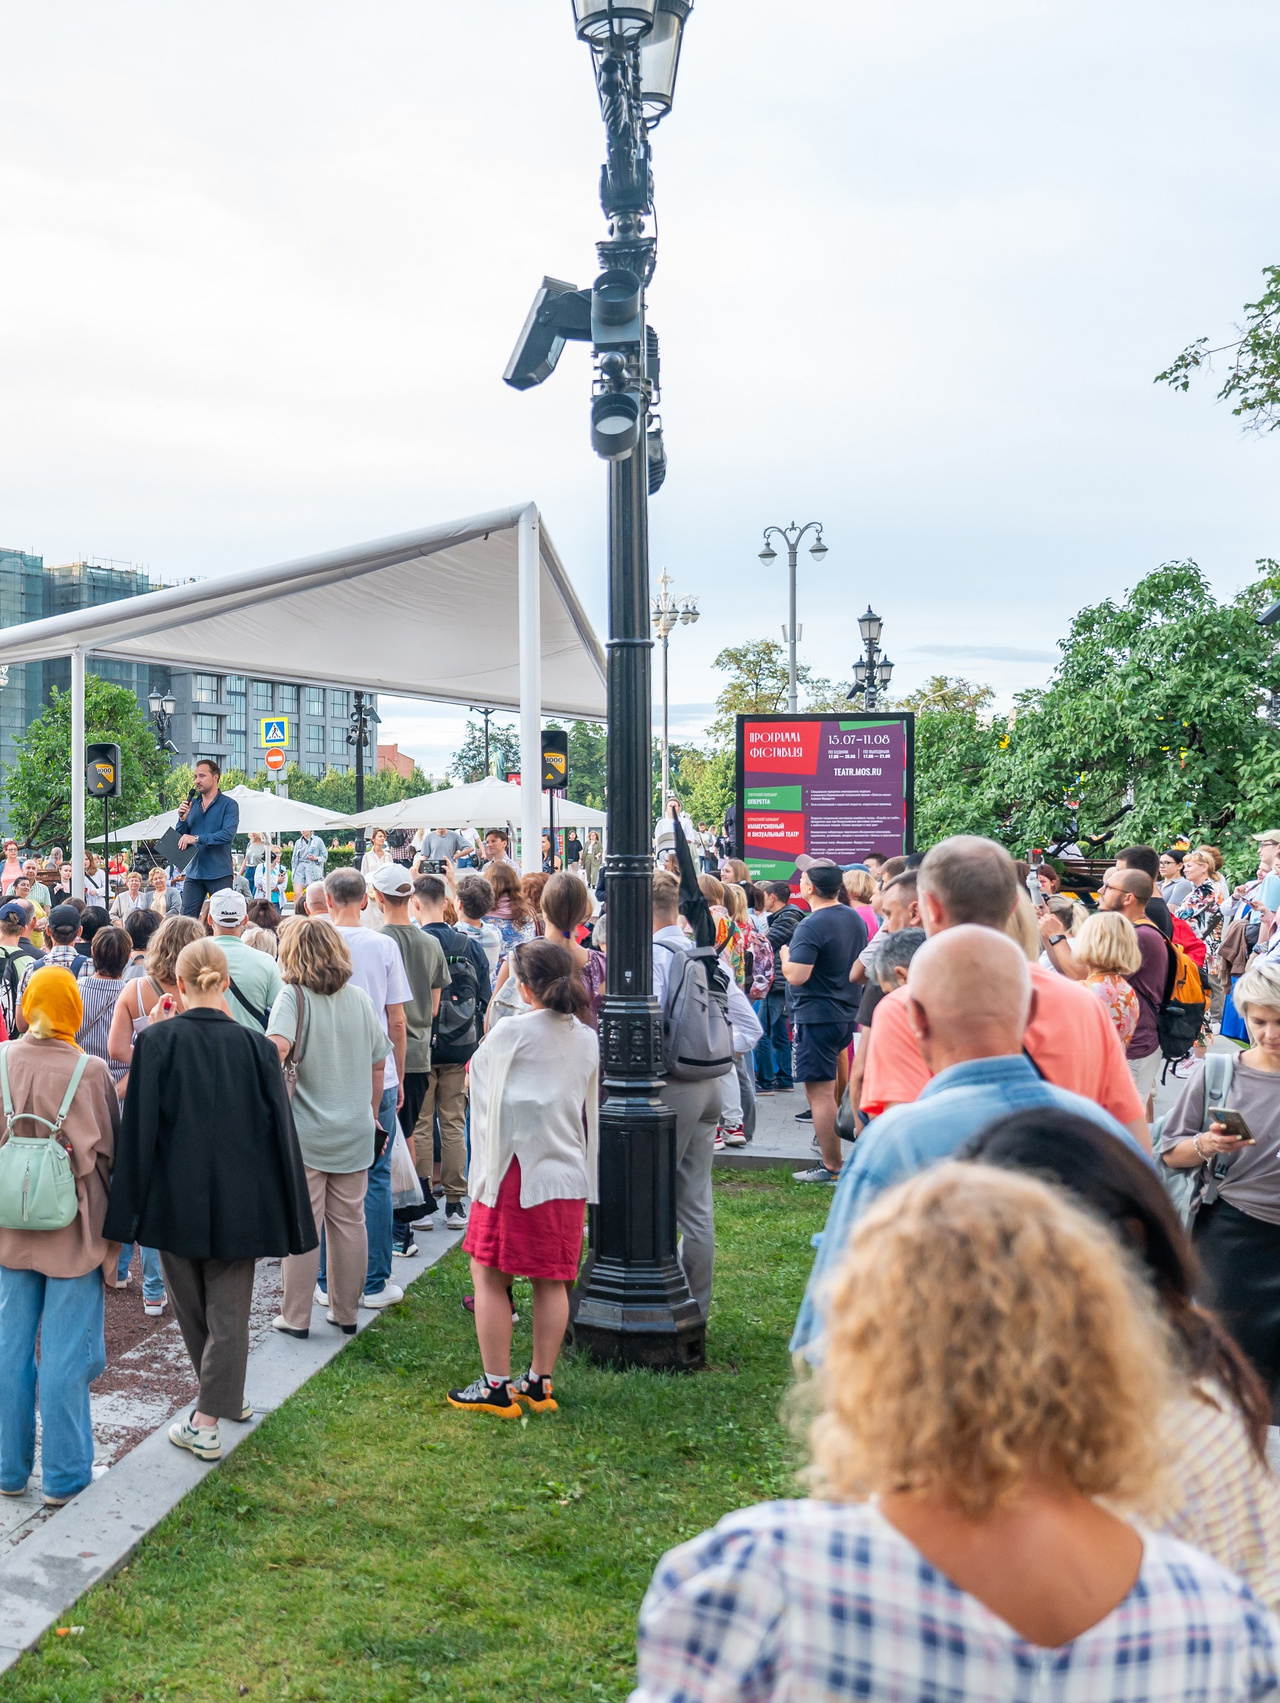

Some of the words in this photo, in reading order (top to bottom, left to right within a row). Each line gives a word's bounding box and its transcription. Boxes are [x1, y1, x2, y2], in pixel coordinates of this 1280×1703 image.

[749, 732, 800, 743] ПРОГРАММА
[749, 747, 803, 758] ФЕСТИВАЛЯ
[833, 767, 882, 776] TEATR.MOS.RU
